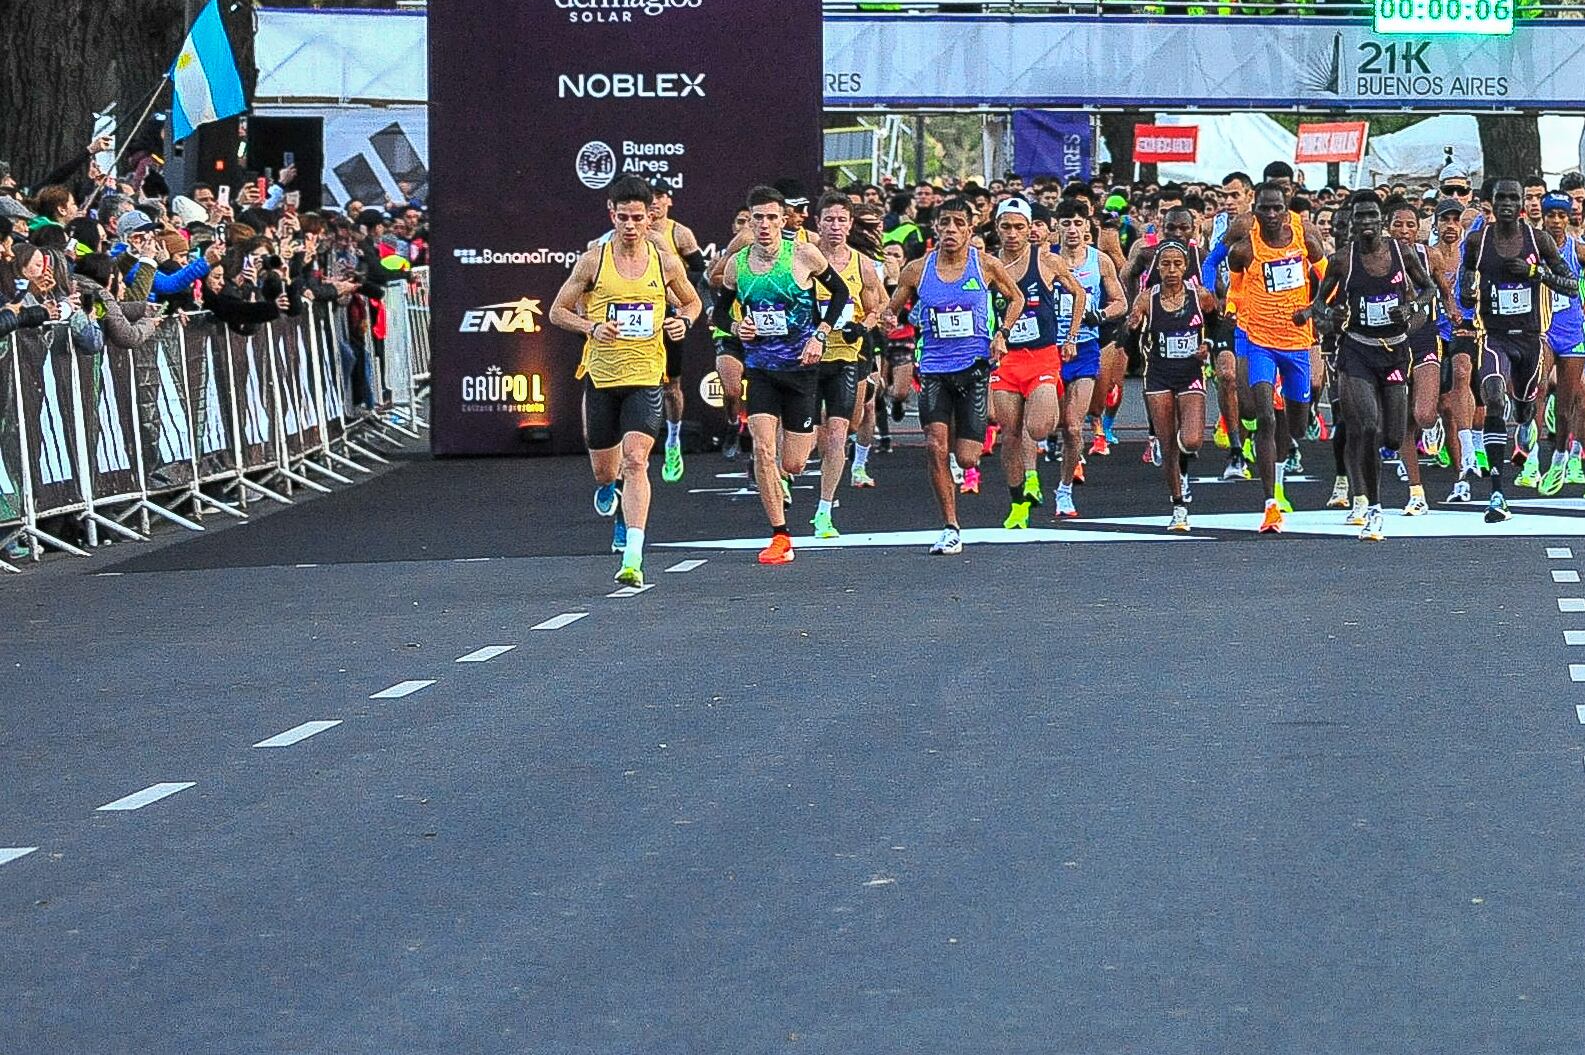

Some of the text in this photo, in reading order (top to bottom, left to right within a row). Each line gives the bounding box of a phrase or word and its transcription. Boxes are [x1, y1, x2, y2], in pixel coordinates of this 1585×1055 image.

[569, 11, 632, 23] SOLAR
[1358, 42, 1432, 74] 21K
[558, 73, 706, 98] NOBLEX
[825, 73, 862, 92] RES
[1357, 76, 1509, 96] BUENOS AIRES
[622, 141, 685, 155] Buenos
[622, 157, 669, 172] Aires
[1286, 268, 1293, 279] 2
[1512, 293, 1519, 304] 8
[630, 314, 642, 326] 24
[763, 314, 775, 325] 25
[950, 315, 959, 327] 15
[1016, 322, 1027, 332] 34
[1177, 338, 1189, 349] 57
[462, 374, 545, 403] GRUPO L
